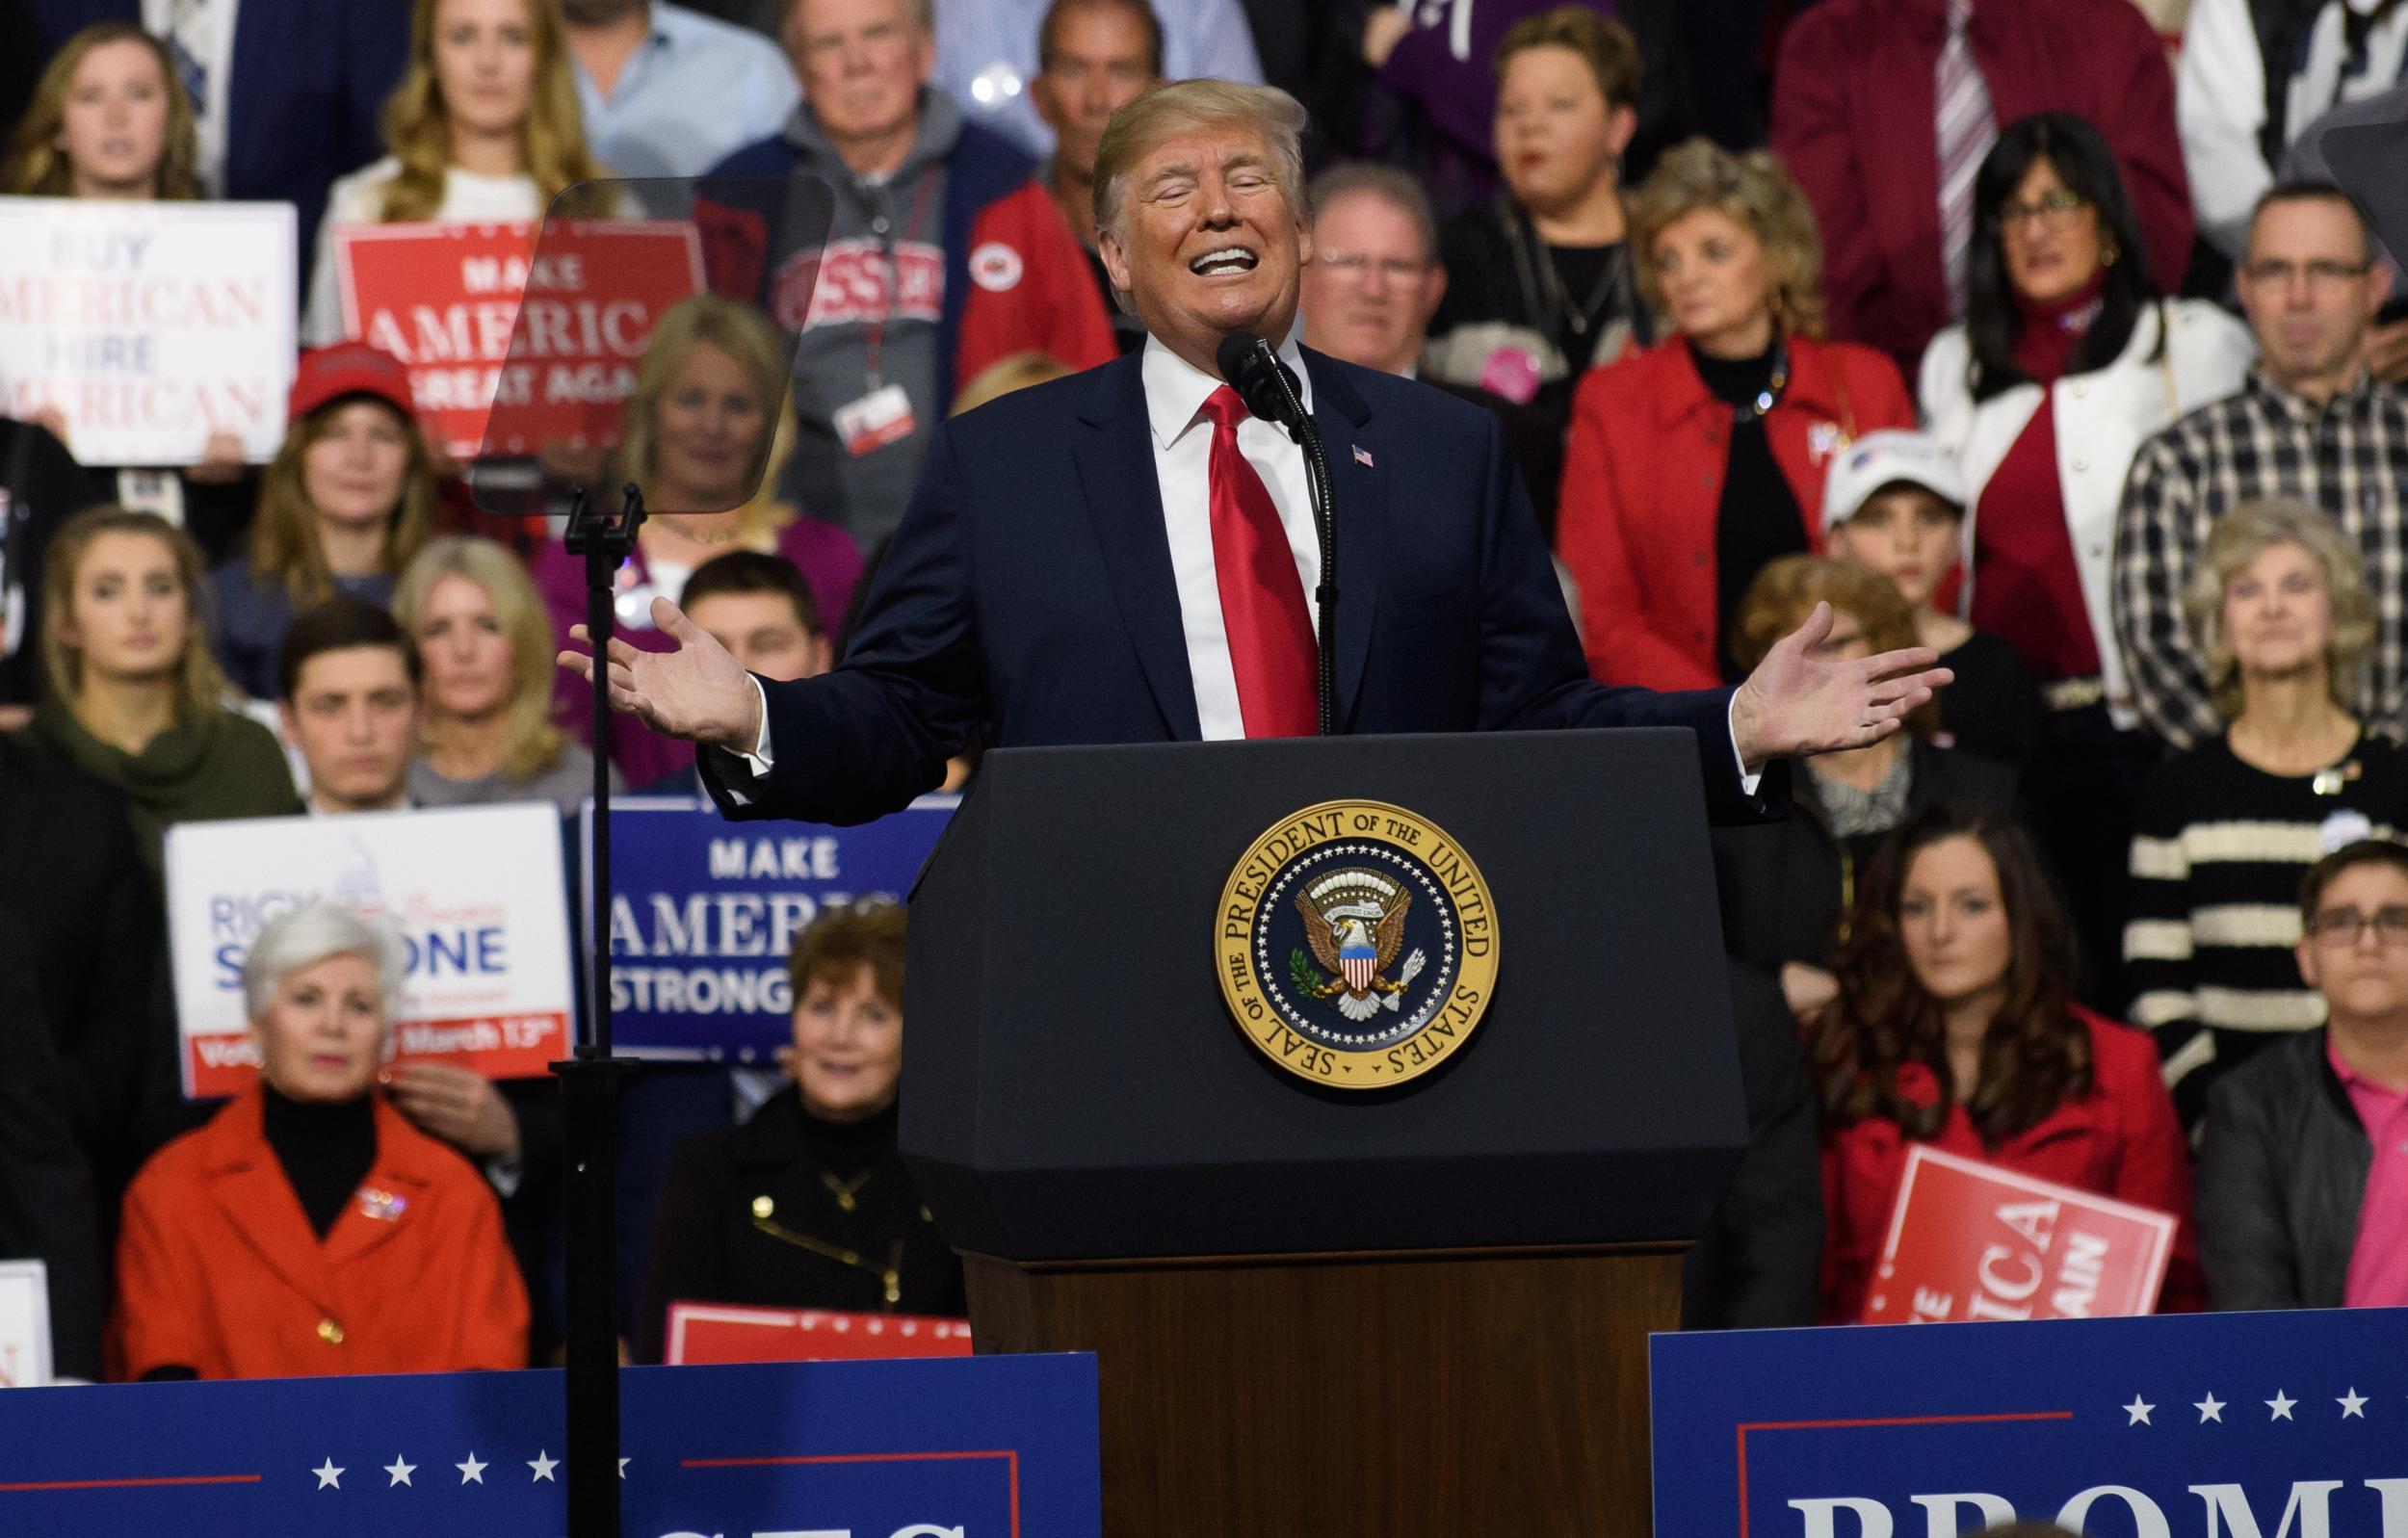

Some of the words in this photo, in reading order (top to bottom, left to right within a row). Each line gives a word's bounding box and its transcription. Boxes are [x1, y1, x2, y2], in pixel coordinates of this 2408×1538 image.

[462, 254, 586, 293] MAKE
[368, 299, 657, 364] AMERIC
[1353, 814, 1379, 831] OF
[1386, 818, 1421, 847] THE
[708, 838, 840, 880] MAKE
[1225, 811, 1344, 941] PRESIDENT
[1428, 842, 1489, 957] UNITED
[611, 966, 793, 1014] STRONG
[1229, 952, 1251, 992] THE
[1241, 996, 1265, 1021] OF
[1387, 984, 1479, 1074] STATES
[403, 1021, 501, 1055] March
[1264, 1017, 1336, 1075] SEAL
